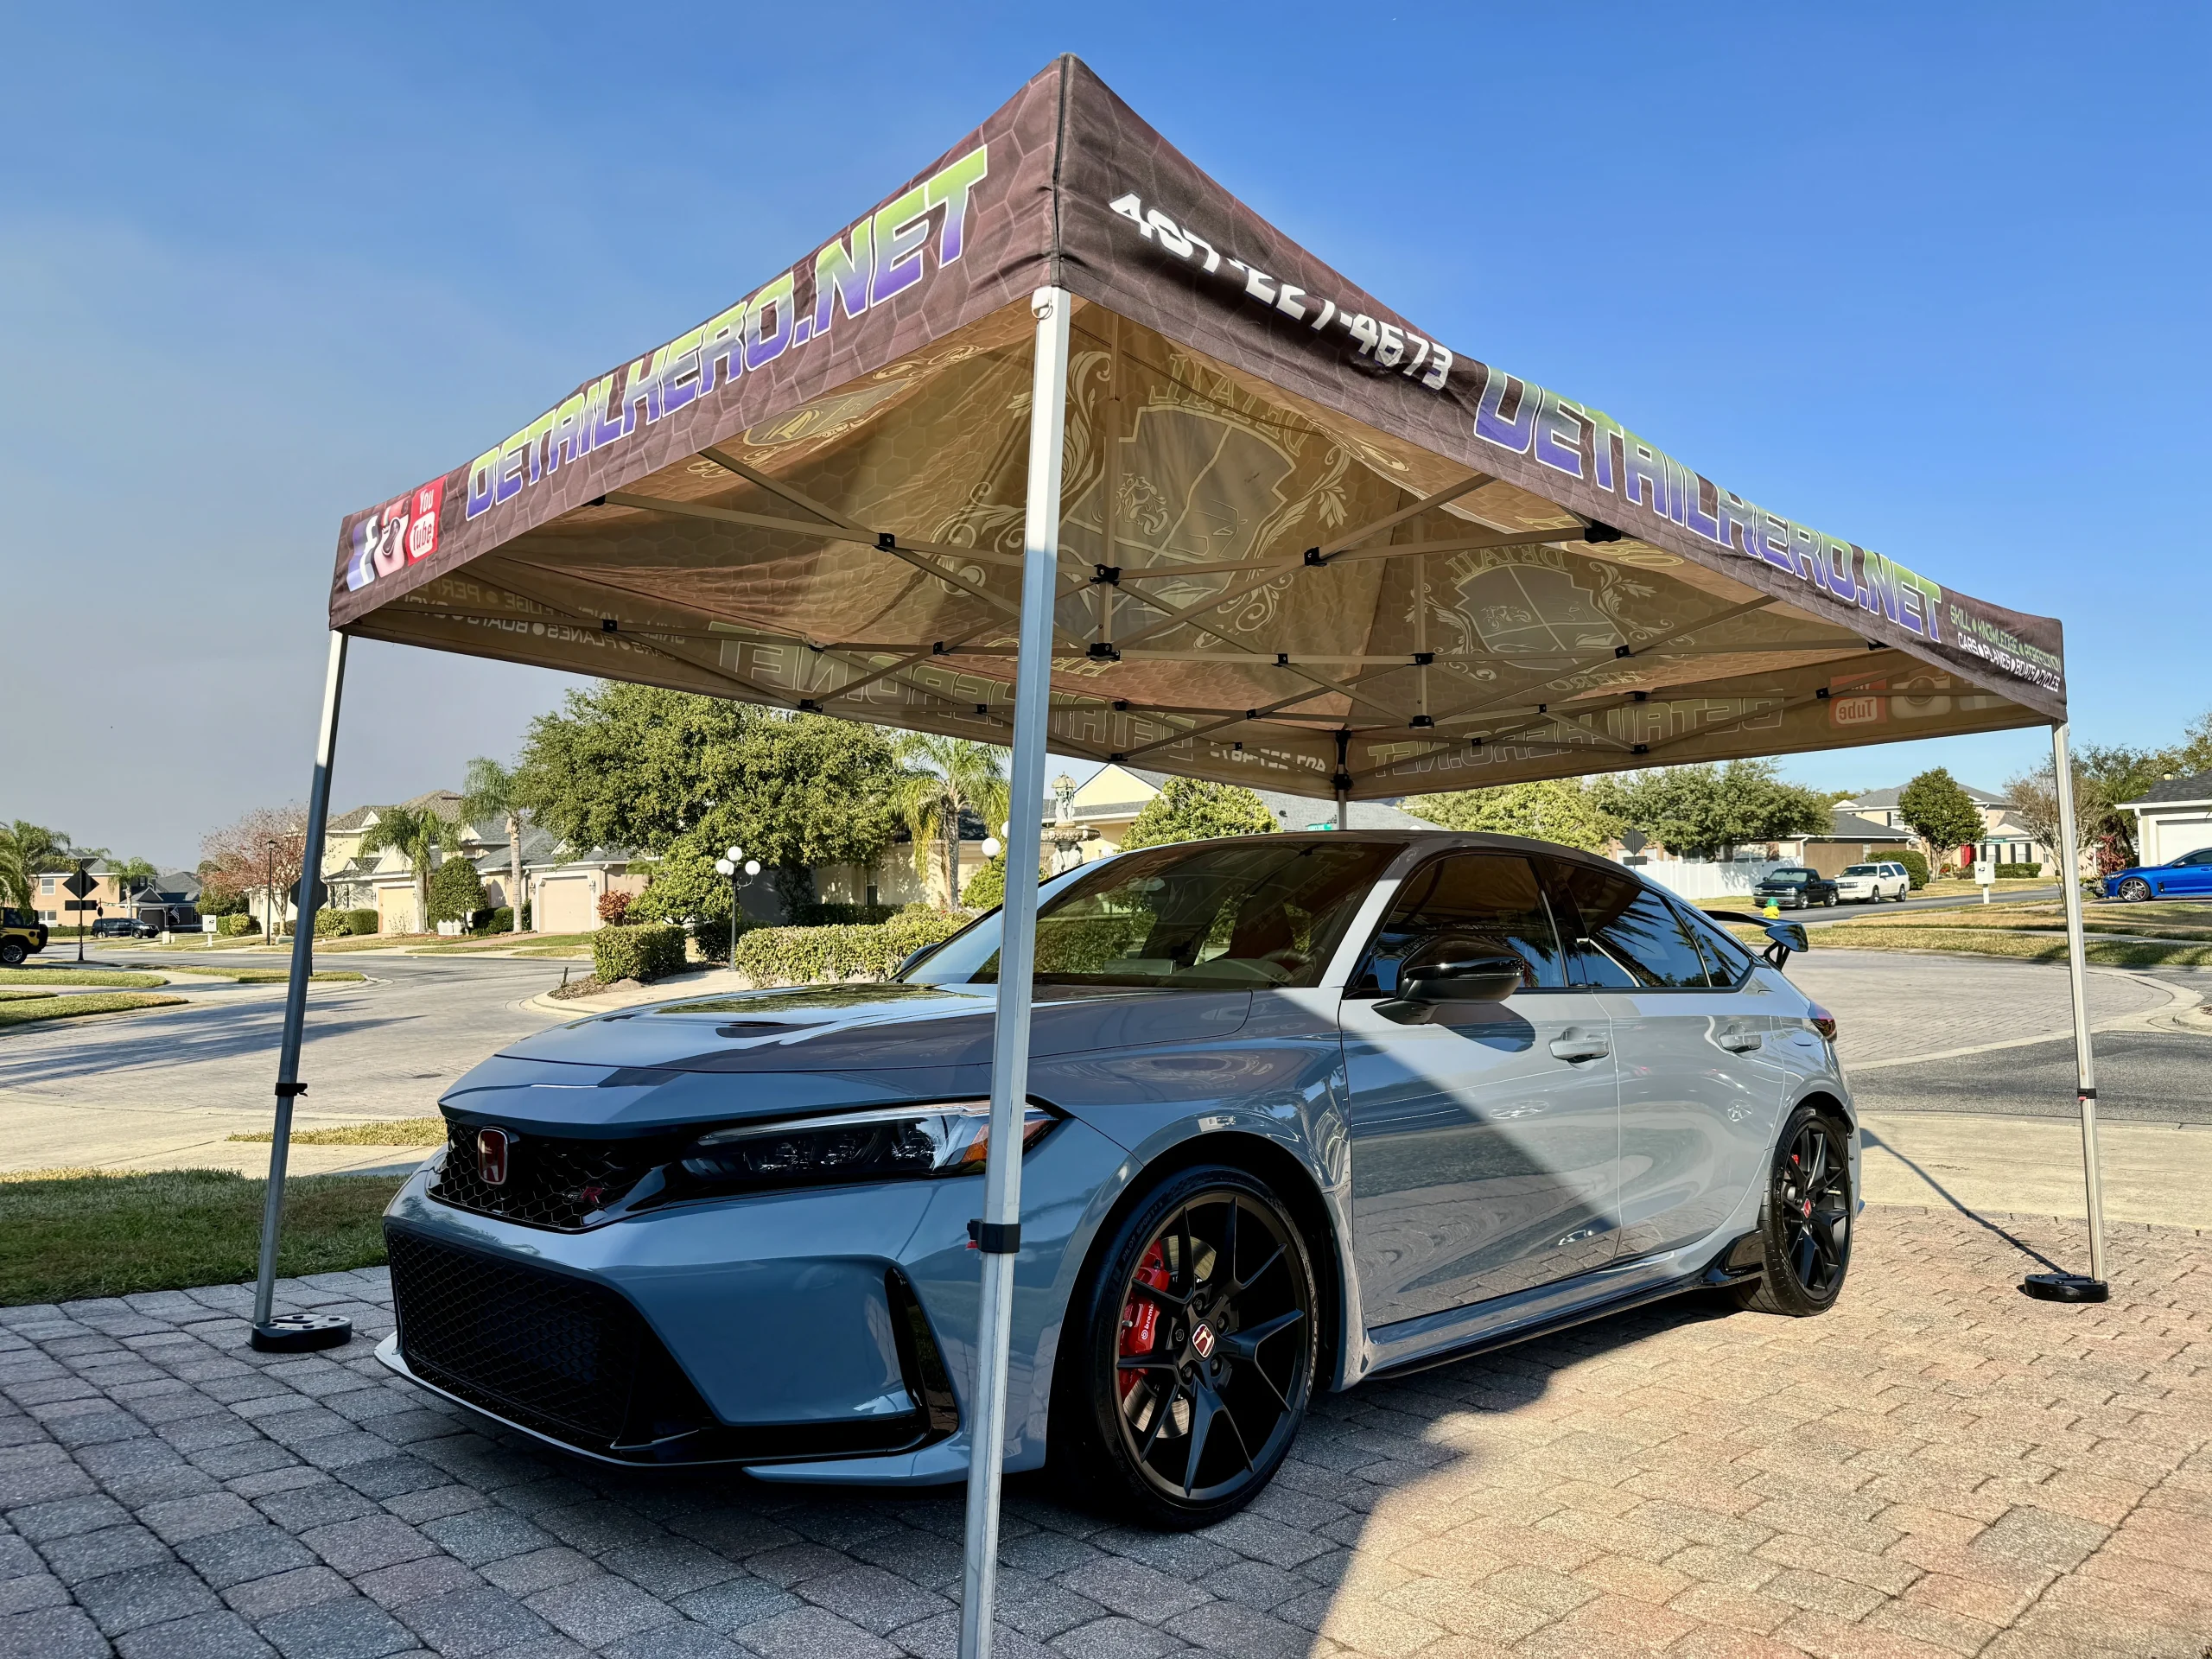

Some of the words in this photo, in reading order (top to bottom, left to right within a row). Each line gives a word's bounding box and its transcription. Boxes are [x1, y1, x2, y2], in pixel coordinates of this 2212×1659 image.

[465, 144, 987, 522] DETAILHERO.NET
[419, 488, 435, 515] You
[1474, 365, 1942, 644] DETAILHERO.NET
[412, 521, 433, 551] Tube
[1949, 605, 1972, 632] SKILL
[1978, 618, 2020, 657] KNOWLEDGE
[1957, 632, 1979, 654] CARS
[1982, 644, 2011, 671] PLANES
[2013, 658, 2036, 682] BOATS
[2036, 669, 2061, 693] CYCLES
